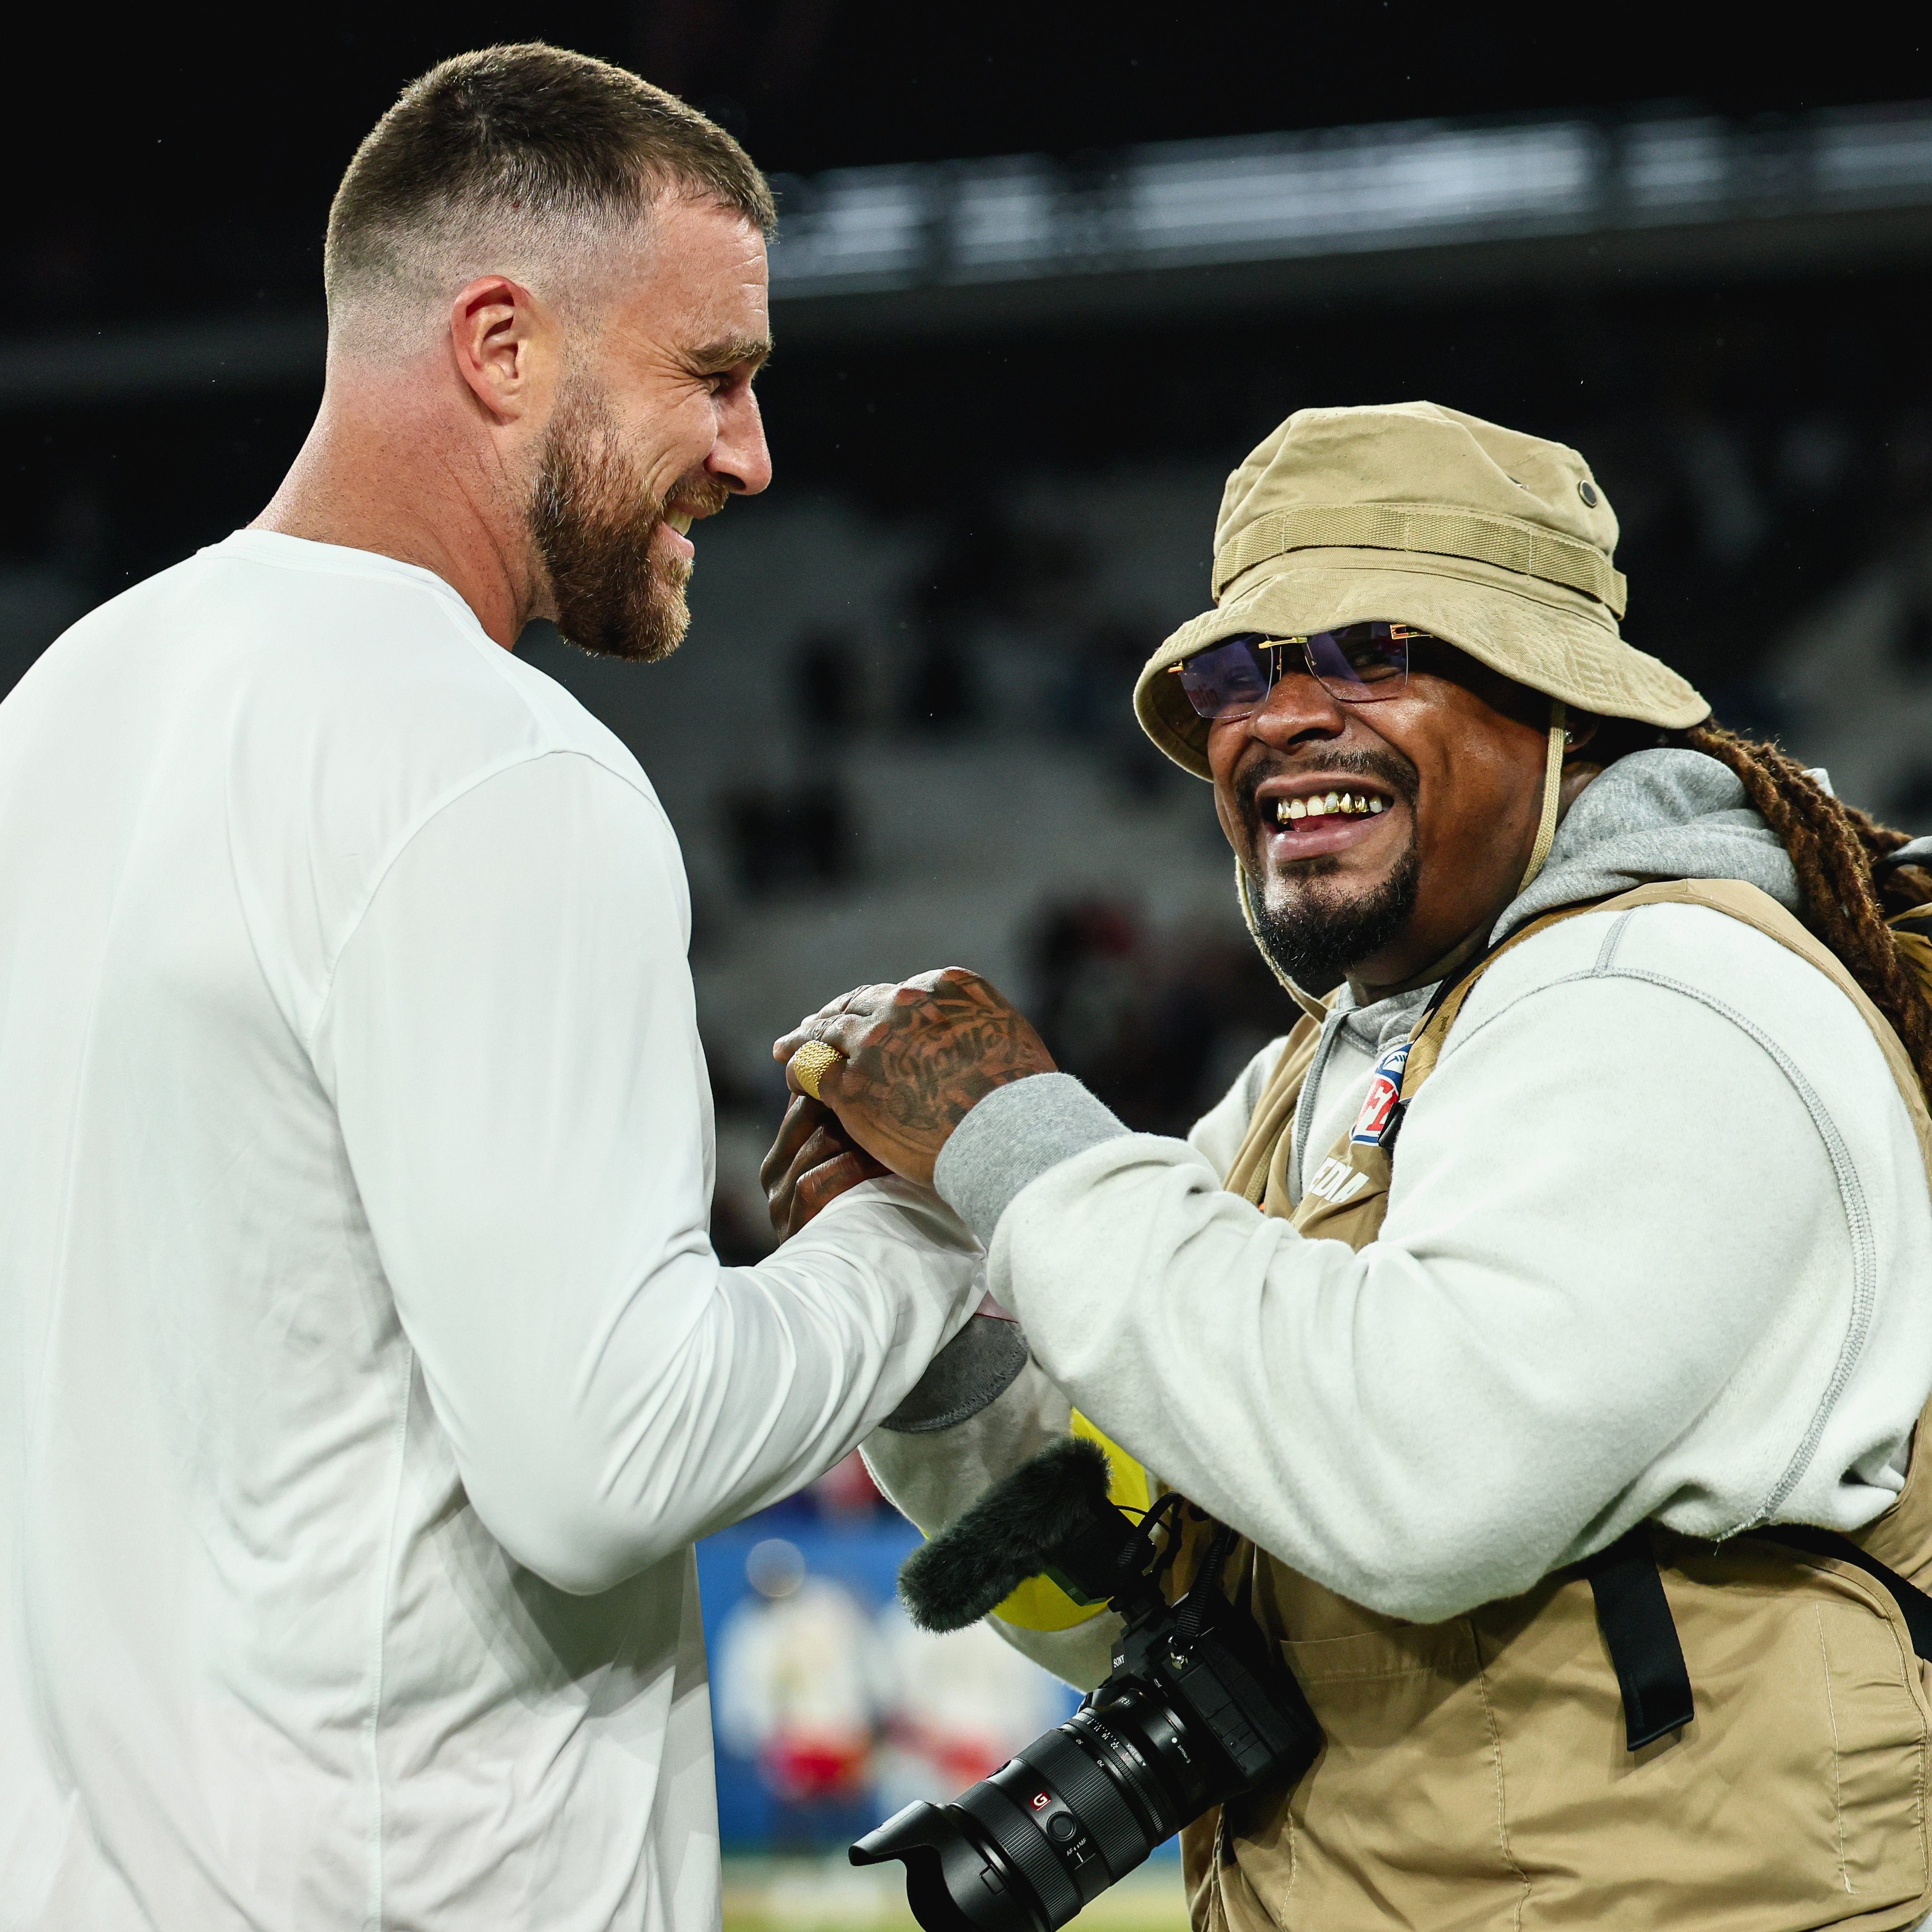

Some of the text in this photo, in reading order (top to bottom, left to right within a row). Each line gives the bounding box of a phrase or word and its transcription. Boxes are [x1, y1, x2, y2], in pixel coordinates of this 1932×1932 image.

[1307, 1156, 1370, 1203] EDIA
[1113, 1654, 1124, 1668] SONY
[1126, 1743, 1137, 1755] LOCK
[1177, 1745, 1191, 1764] E-mount
[1033, 1793, 1048, 1806] G
[1067, 1838, 1086, 1857] AF MF
